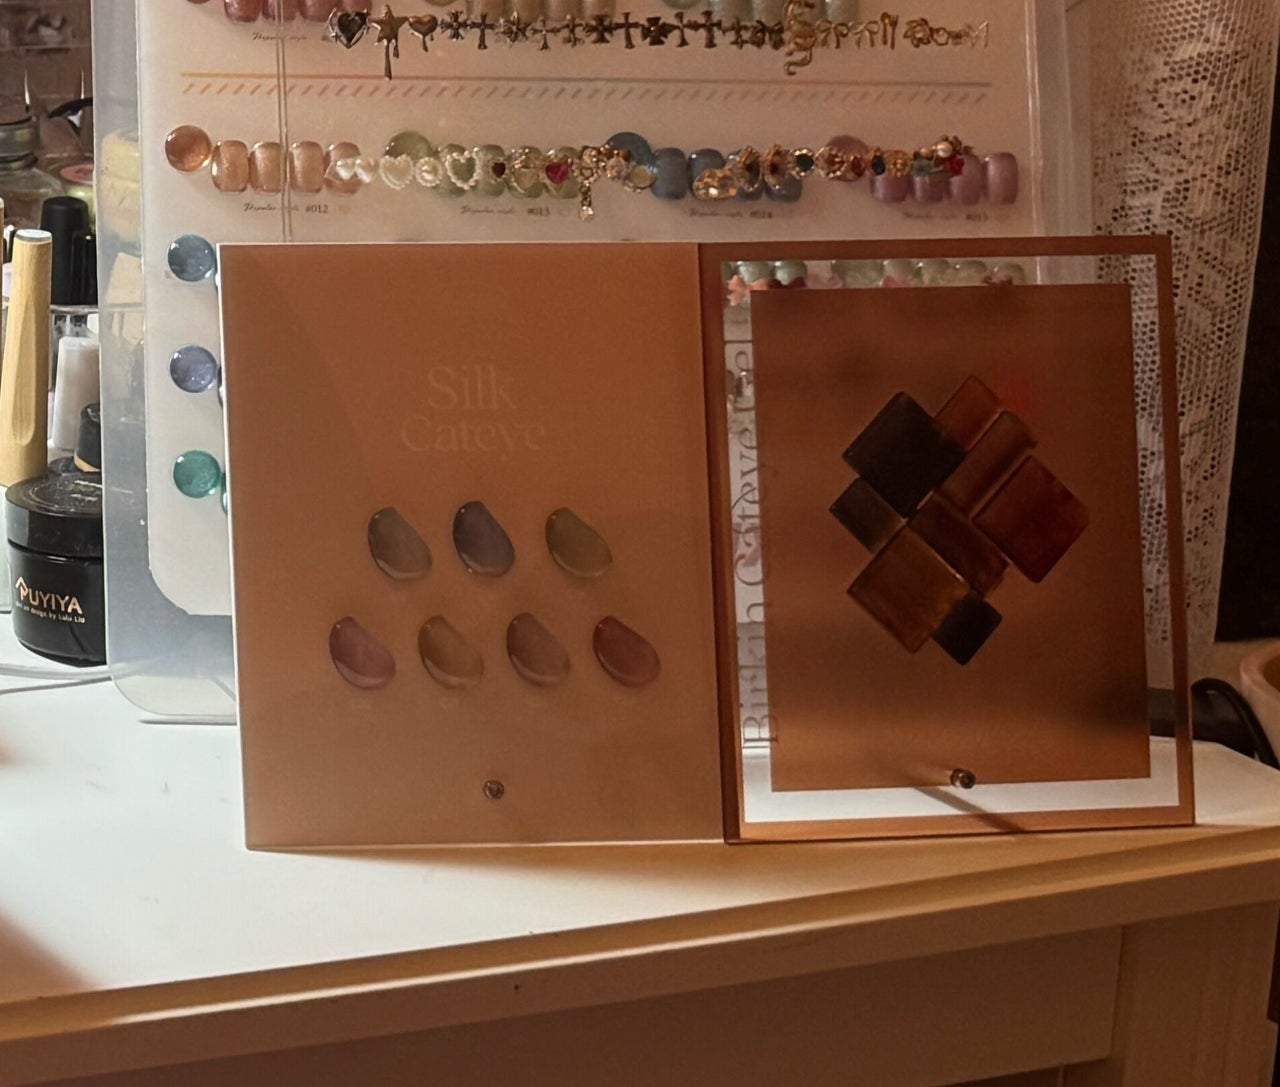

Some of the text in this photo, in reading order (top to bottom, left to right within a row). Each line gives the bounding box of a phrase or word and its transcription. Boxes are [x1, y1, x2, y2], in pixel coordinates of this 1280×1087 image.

[305, 203, 329, 214] #012
[426, 363, 518, 410] Silk
[400, 414, 546, 463] Cateye
[15, 576, 84, 615] PUYIYA
